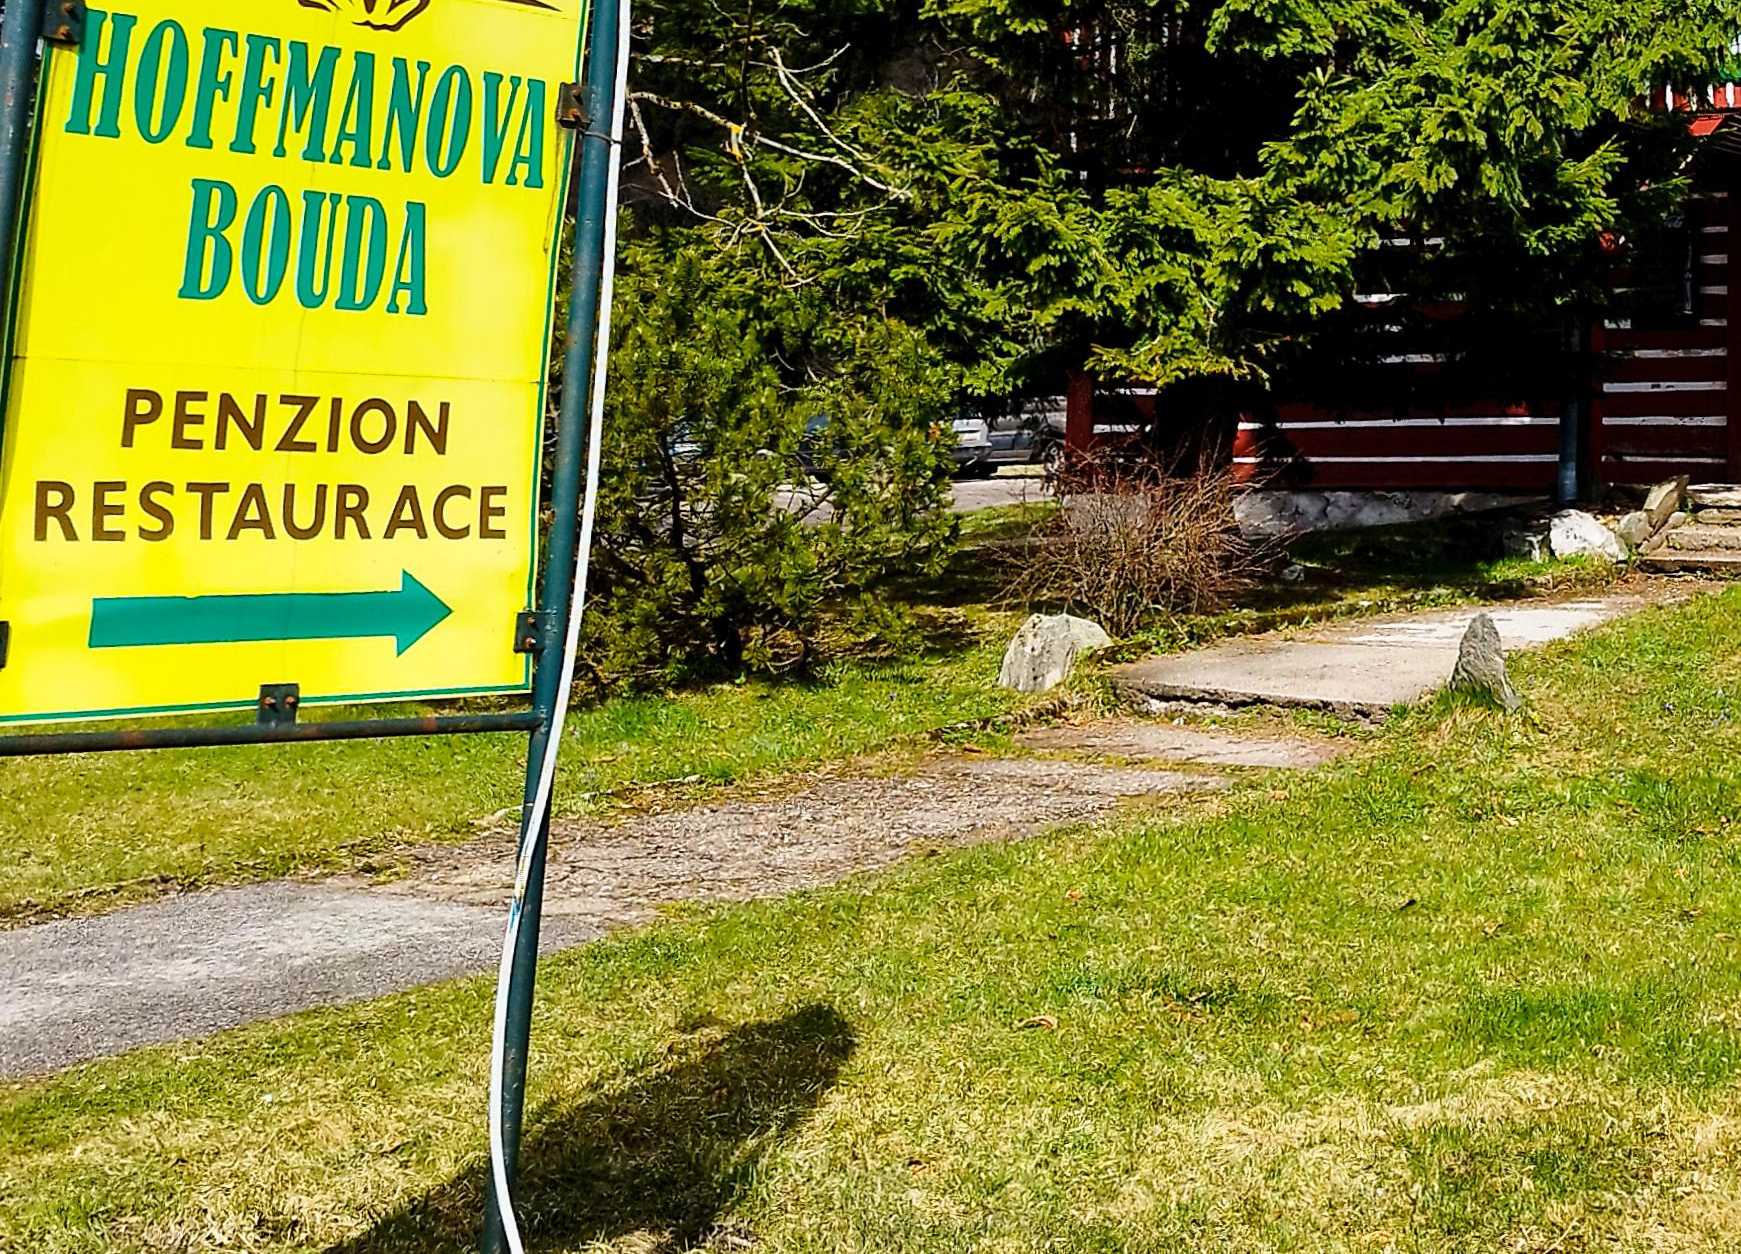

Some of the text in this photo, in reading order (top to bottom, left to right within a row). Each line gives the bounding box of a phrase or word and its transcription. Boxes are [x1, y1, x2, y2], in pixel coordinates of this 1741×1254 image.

[64, 9, 546, 190] HOFFMANOVA
[177, 177, 429, 316] BOUDA
[120, 388, 451, 456] PENZION
[33, 480, 507, 542] RESTAURACE
